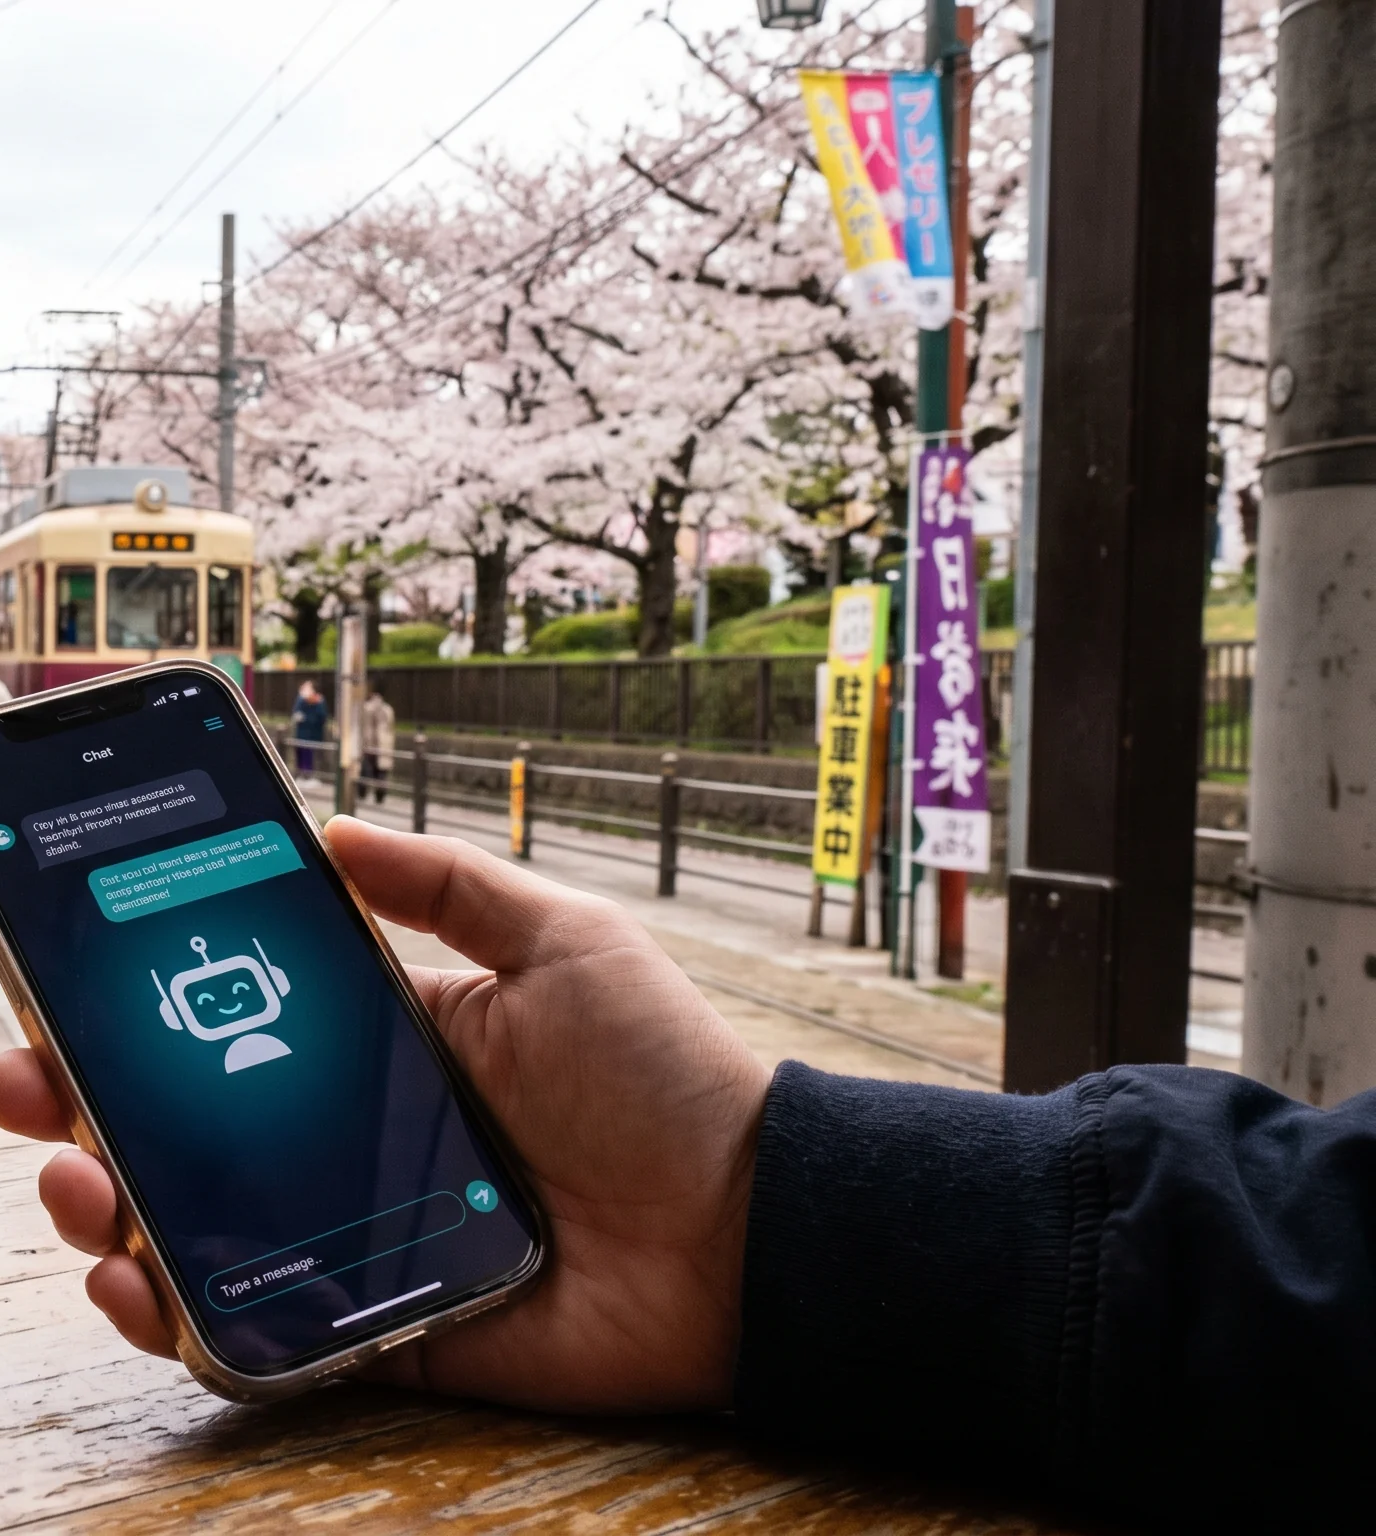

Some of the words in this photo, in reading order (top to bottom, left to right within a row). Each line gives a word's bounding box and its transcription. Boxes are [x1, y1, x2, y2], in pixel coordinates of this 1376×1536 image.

[82, 747, 114, 763] Chat
[220, 1280, 251, 1297] Type
[252, 1276, 262, 1286] a
